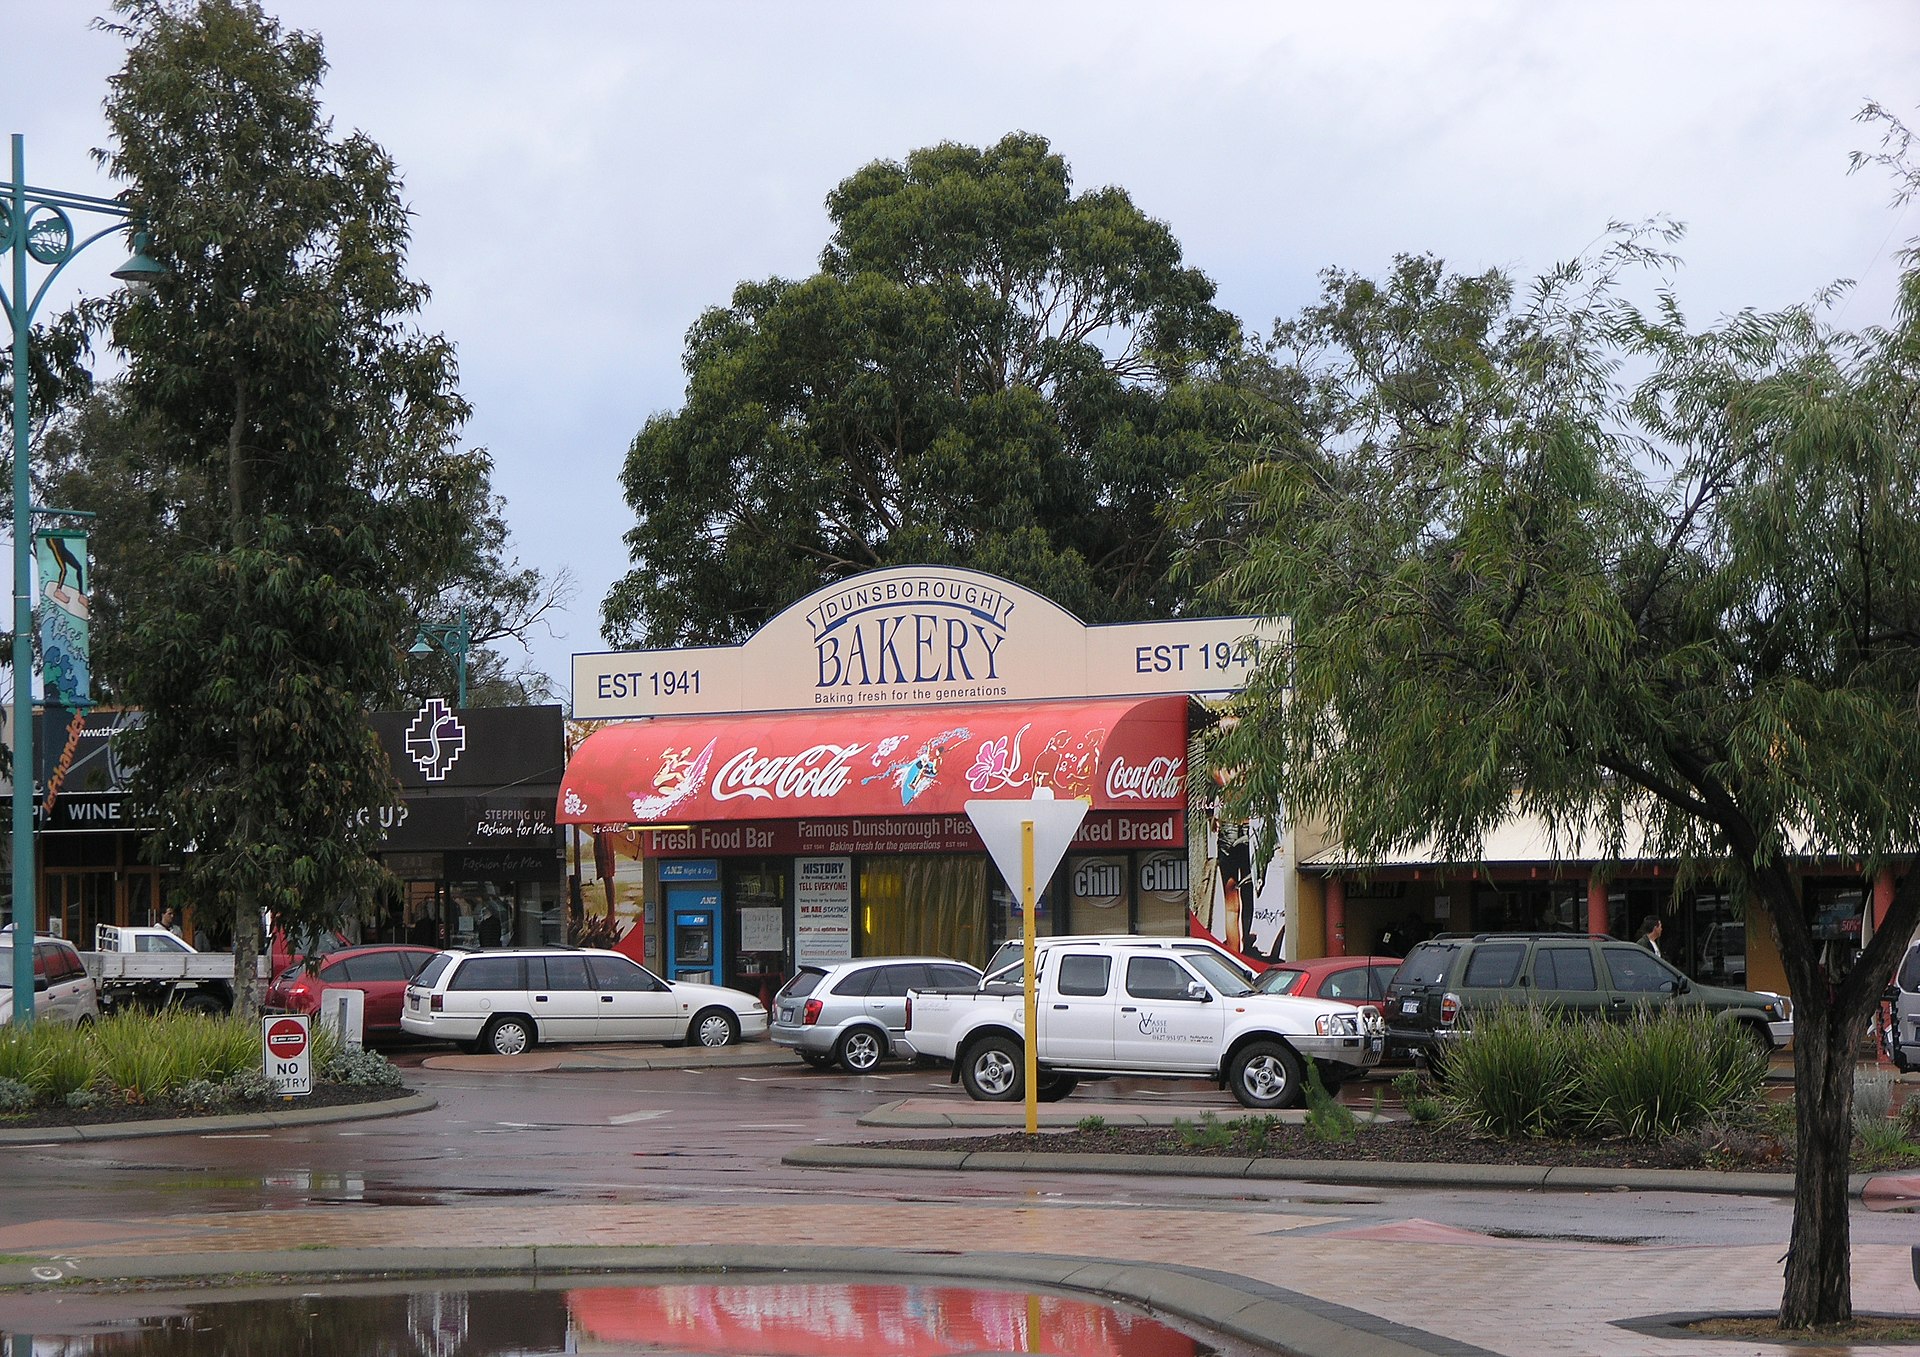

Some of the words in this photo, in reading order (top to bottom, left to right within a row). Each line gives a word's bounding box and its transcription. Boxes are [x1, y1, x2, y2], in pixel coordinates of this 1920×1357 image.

[826, 581, 995, 618] DUNSBOROUGH
[814, 613, 1006, 688] BAKERY
[1135, 644, 1190, 674] EST
[598, 672, 642, 699] EST
[649, 669, 700, 696] 1941
[814, 692, 853, 704] Baking
[858, 691, 887, 701] fresh
[892, 689, 908, 700] for
[913, 688, 931, 699] the
[936, 685, 1007, 700] generations
[711, 742, 872, 801] Coca-Cola
[1105, 756, 1184, 799] Coca-Cola
[68, 802, 121, 820] WINE
[485, 809, 530, 820] STEPPING
[533, 810, 547, 820] UP
[476, 820, 513, 837] Fashion
[516, 819, 531, 838] for
[533, 822, 554, 836] Men
[798, 821, 849, 837] Famous
[852, 818, 940, 839] Dunsborough
[944, 817, 973, 835] Pies
[1072, 819, 1112, 841] ked
[1118, 817, 1173, 841] Bread
[652, 828, 696, 850] Fresh
[701, 827, 741, 849] Food
[746, 827, 775, 848] Bar
[829, 841, 854, 852] Baking
[855, 840, 873, 851] fresh
[875, 840, 885, 851] for
[886, 840, 898, 851] the
[899, 840, 941, 852] generations
[664, 866, 683, 875] ANZ
[803, 862, 844, 874] HISTORY
[1141, 859, 1189, 891] chill
[799, 882, 813, 891] TELL
[814, 881, 848, 891] EVERYONE!
[1075, 864, 1121, 897] chill
[700, 896, 717, 904] ANZ
[277, 1062, 298, 1075] NO
[277, 1077, 307, 1088] NTRY
